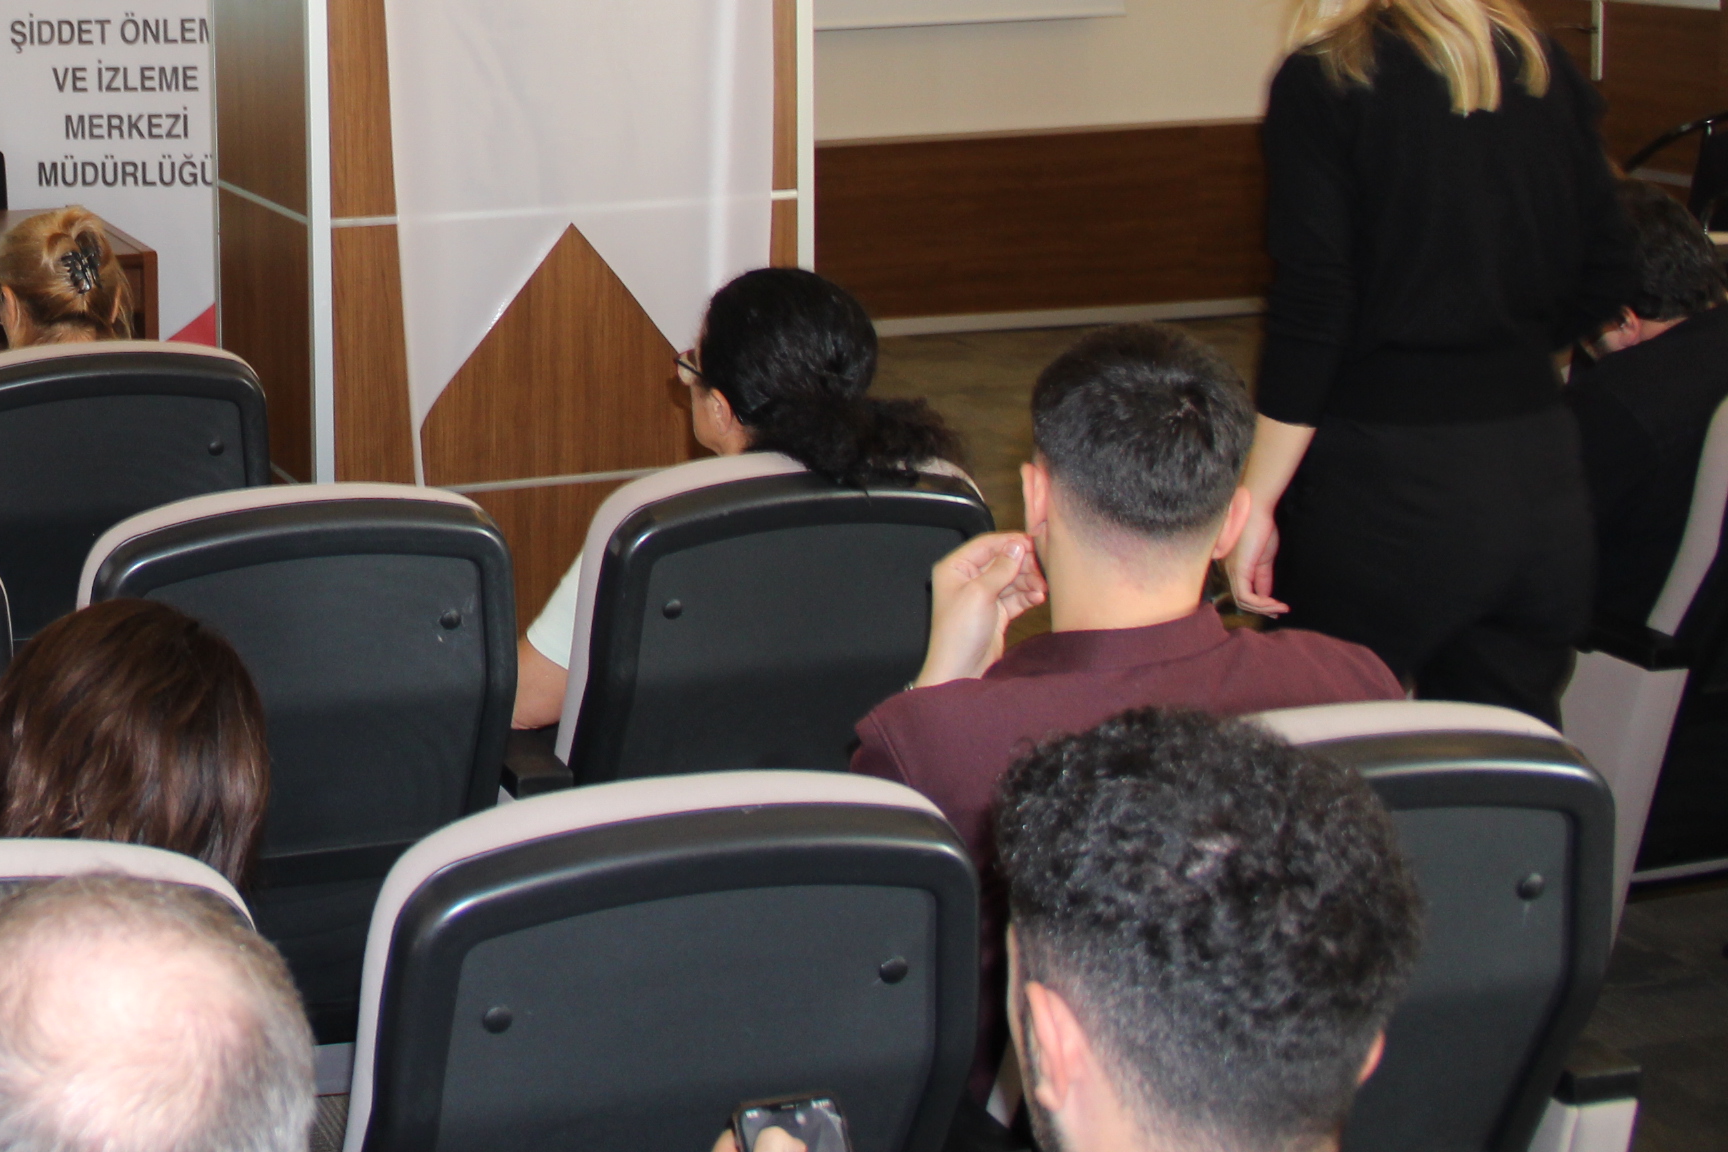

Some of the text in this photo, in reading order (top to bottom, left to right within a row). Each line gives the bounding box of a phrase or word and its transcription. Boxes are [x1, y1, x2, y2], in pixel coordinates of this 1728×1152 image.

[10, 13, 111, 54] ŞİDDET
[52, 59, 199, 93] VE İZLEME
[65, 106, 189, 140] MERKEZİ
[38, 153, 213, 187] MÜDÜRLÜĞÜ
